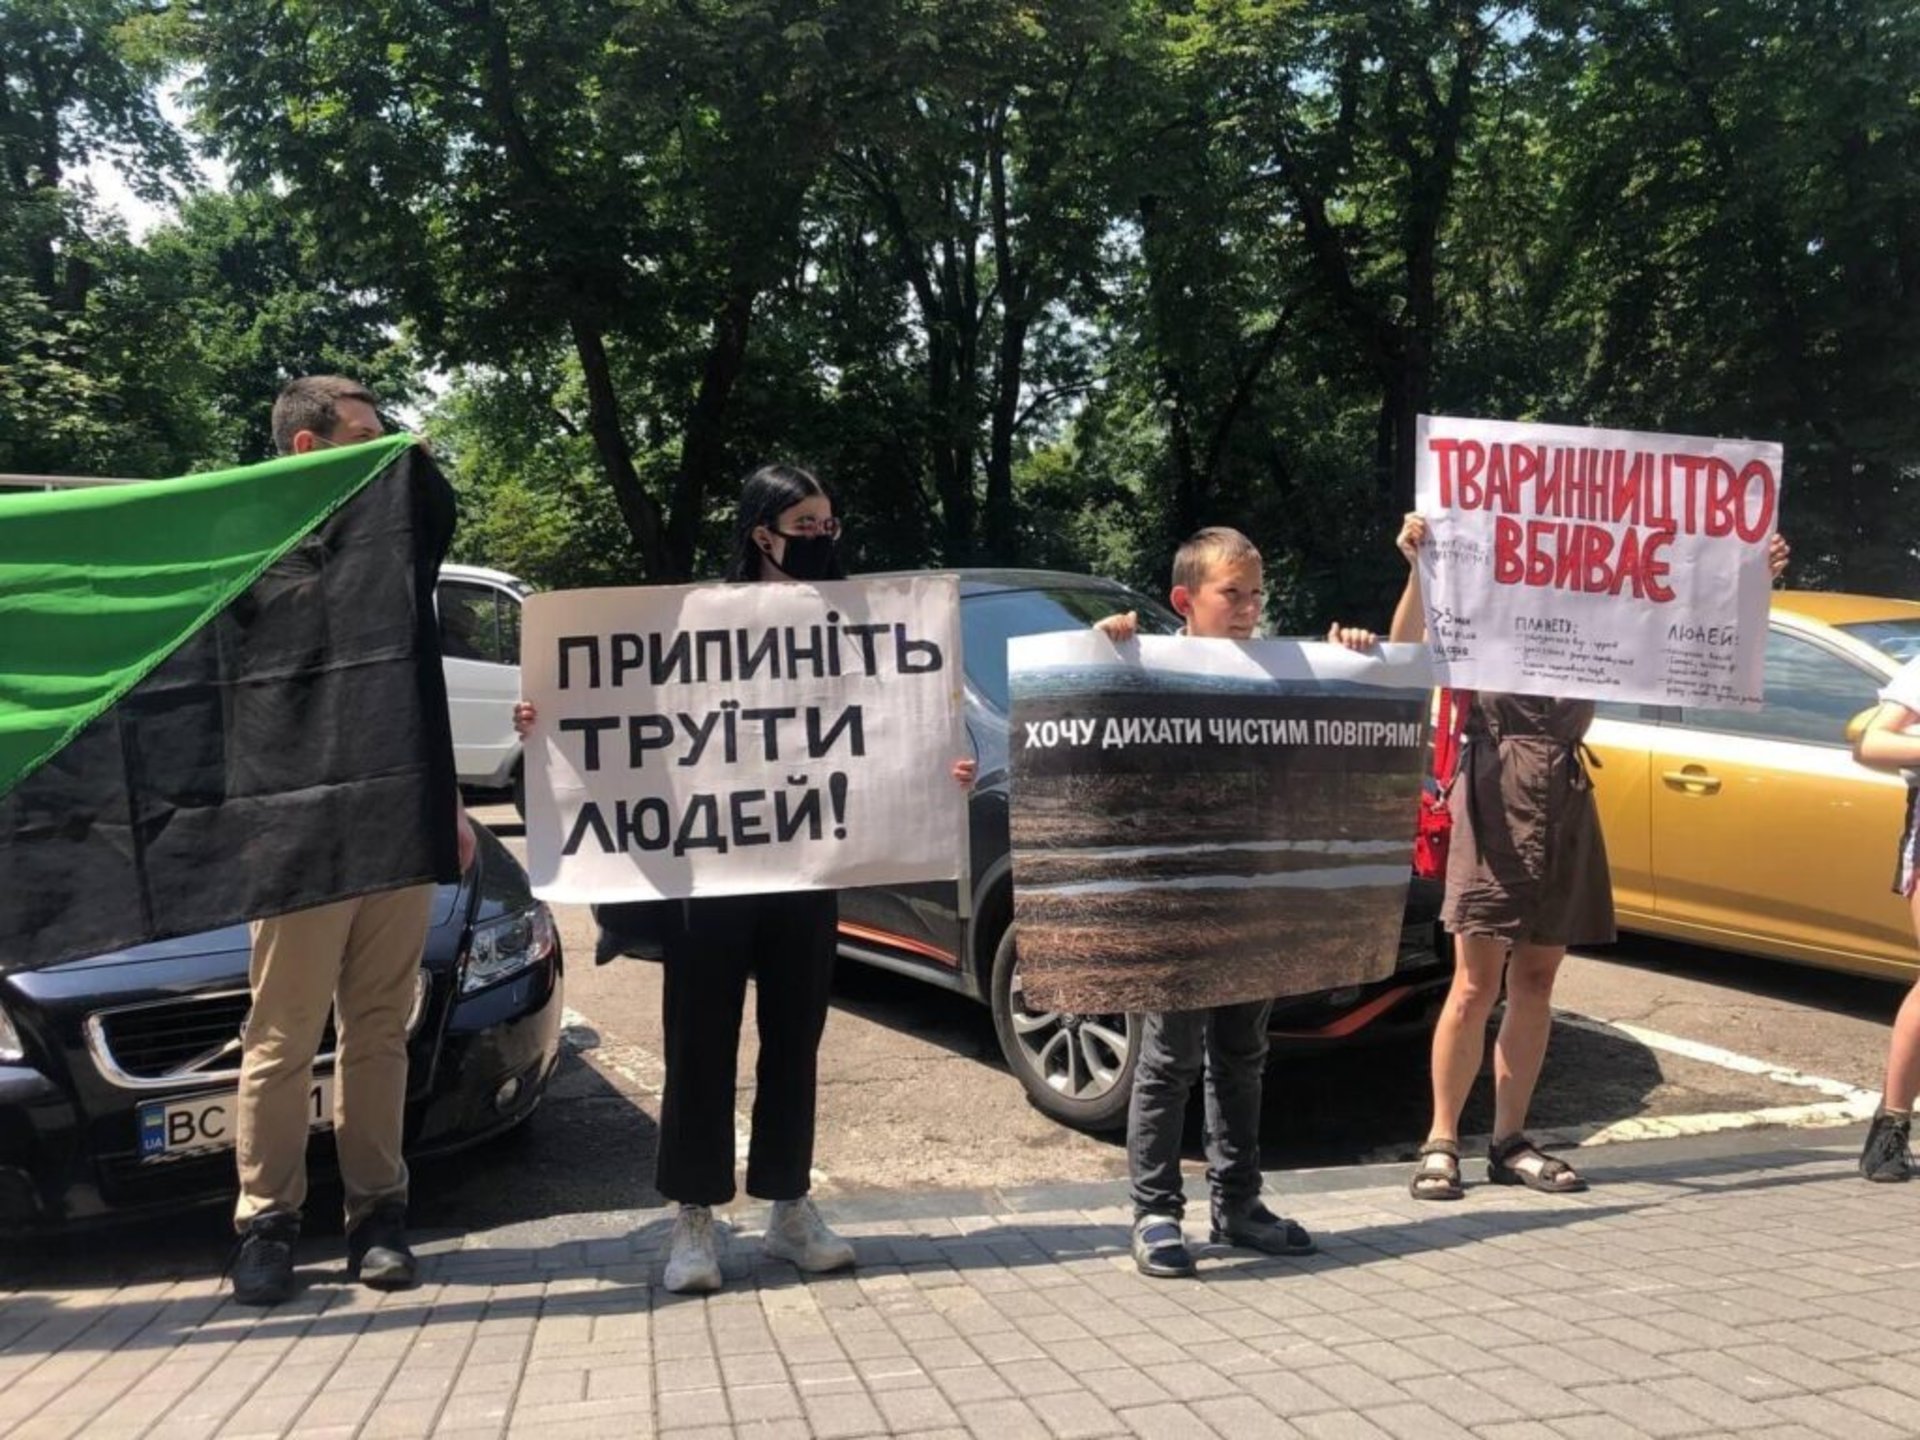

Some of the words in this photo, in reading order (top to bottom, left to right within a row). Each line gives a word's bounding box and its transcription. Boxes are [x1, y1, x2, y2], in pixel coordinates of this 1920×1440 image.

[1429, 438, 1775, 544] ТВАРИННИЦТВО
[1494, 515, 1677, 603] ВБИВАЄ
[559, 699, 866, 771] ТРУЇТИ
[1025, 718, 1097, 749] ХОЧУ
[1101, 717, 1202, 750] ДИХАТИ
[1208, 718, 1309, 746] ЧИСТИМ
[1314, 719, 1422, 749] ПОВІТРЯМ!
[561, 771, 849, 857] ЛЮДЕЙ!
[145, 1138, 163, 1150] UA
